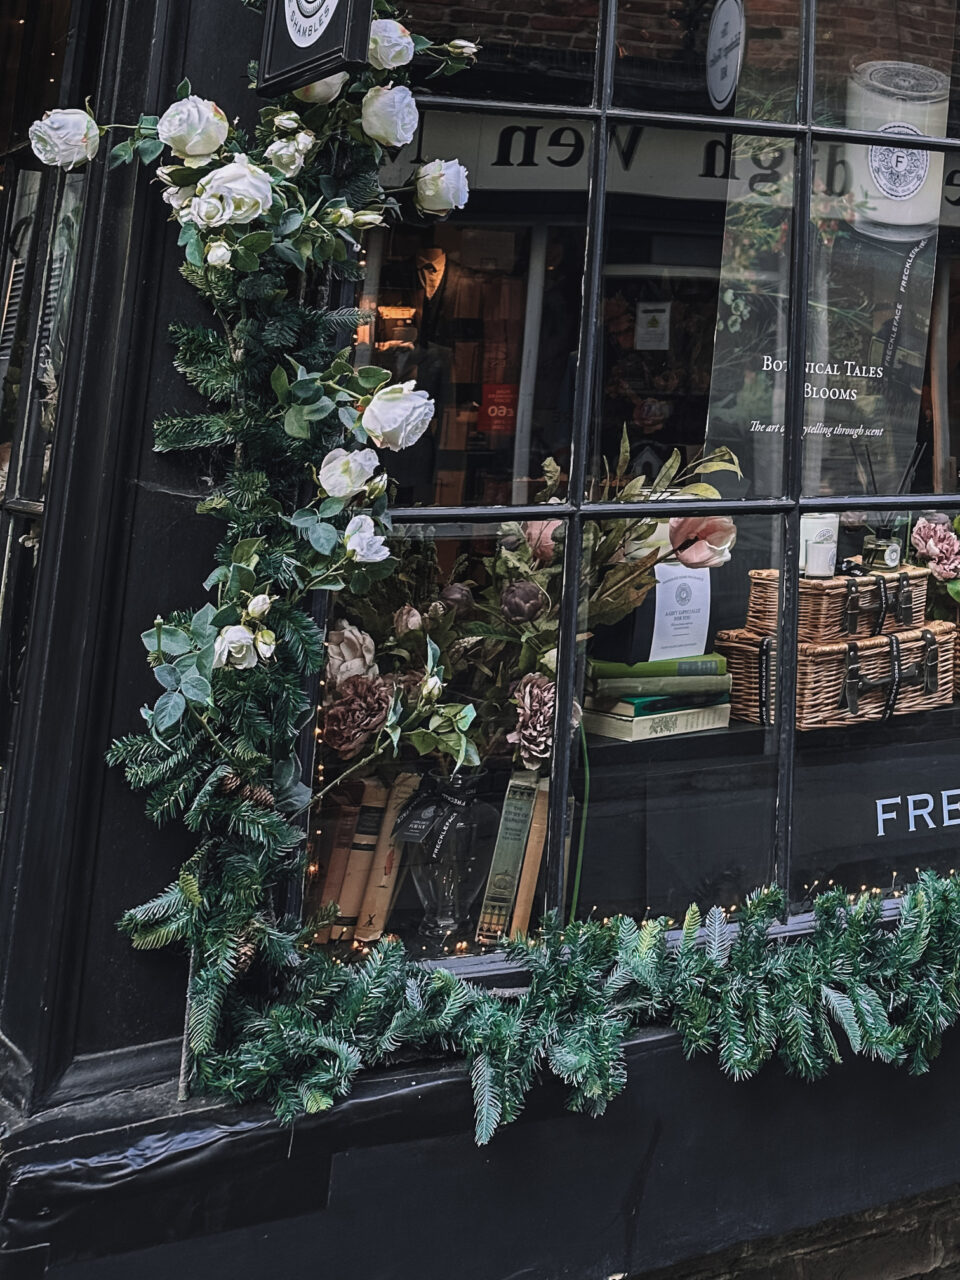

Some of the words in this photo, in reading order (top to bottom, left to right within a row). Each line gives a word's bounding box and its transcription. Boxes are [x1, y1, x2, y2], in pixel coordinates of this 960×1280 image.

[290, 4, 330, 37] SHAMBLES
[895, 155, 905, 168] F
[884, 302, 903, 367] FRECKLEFACE
[762, 355, 841, 376] BOTNICAL
[750, 420, 765, 432] The
[766, 423, 781, 432] art
[802, 422, 832, 440] ytelling
[833, 423, 864, 439] through
[865, 426, 884, 436] scent
